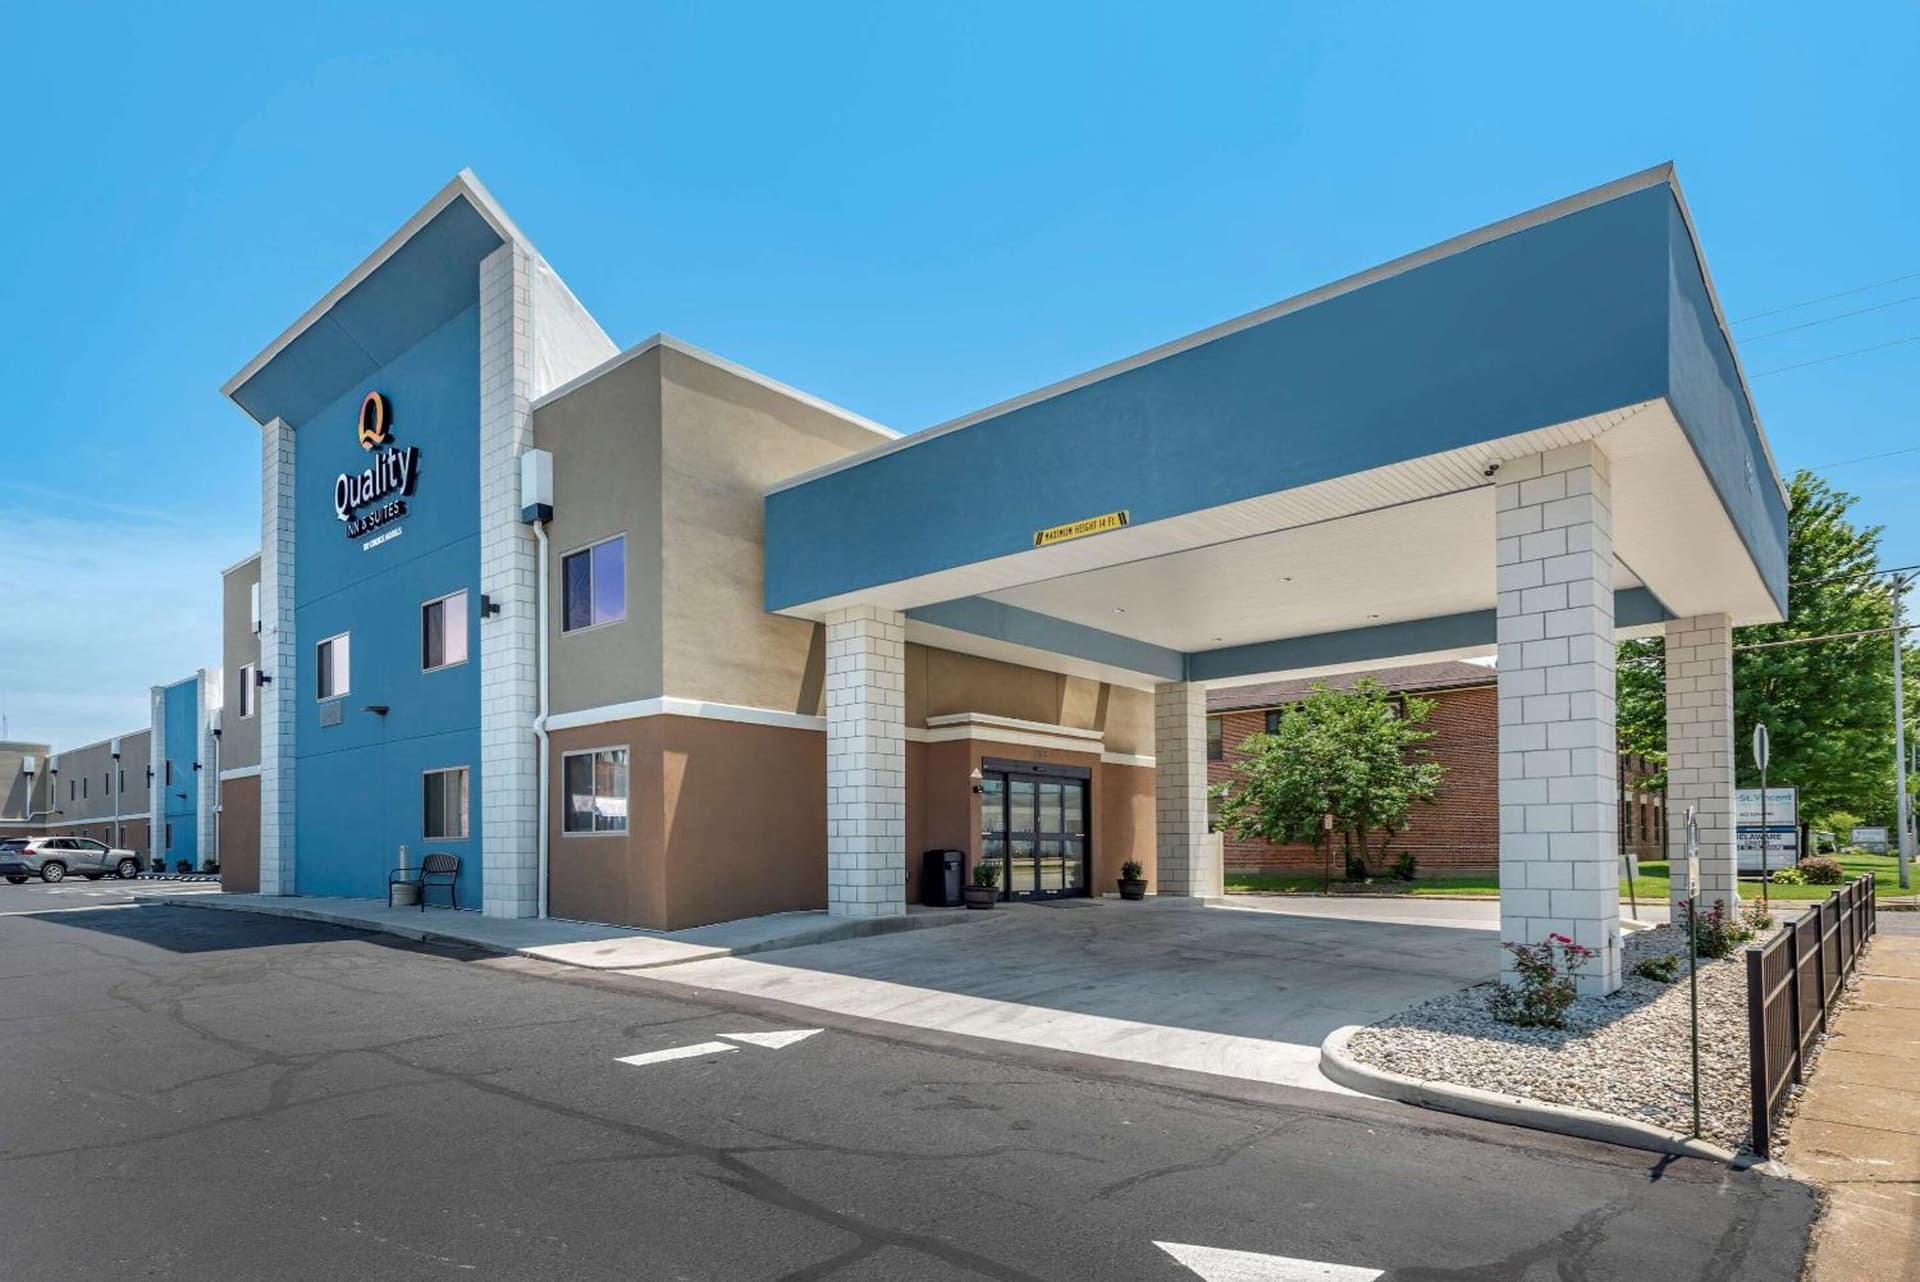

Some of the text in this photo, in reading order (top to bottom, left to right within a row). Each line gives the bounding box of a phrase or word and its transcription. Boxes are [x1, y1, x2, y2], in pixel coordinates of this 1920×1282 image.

[358, 391, 385, 450] Q
[334, 448, 411, 521] Quality
[1075, 521, 1097, 533] HEIGHT
